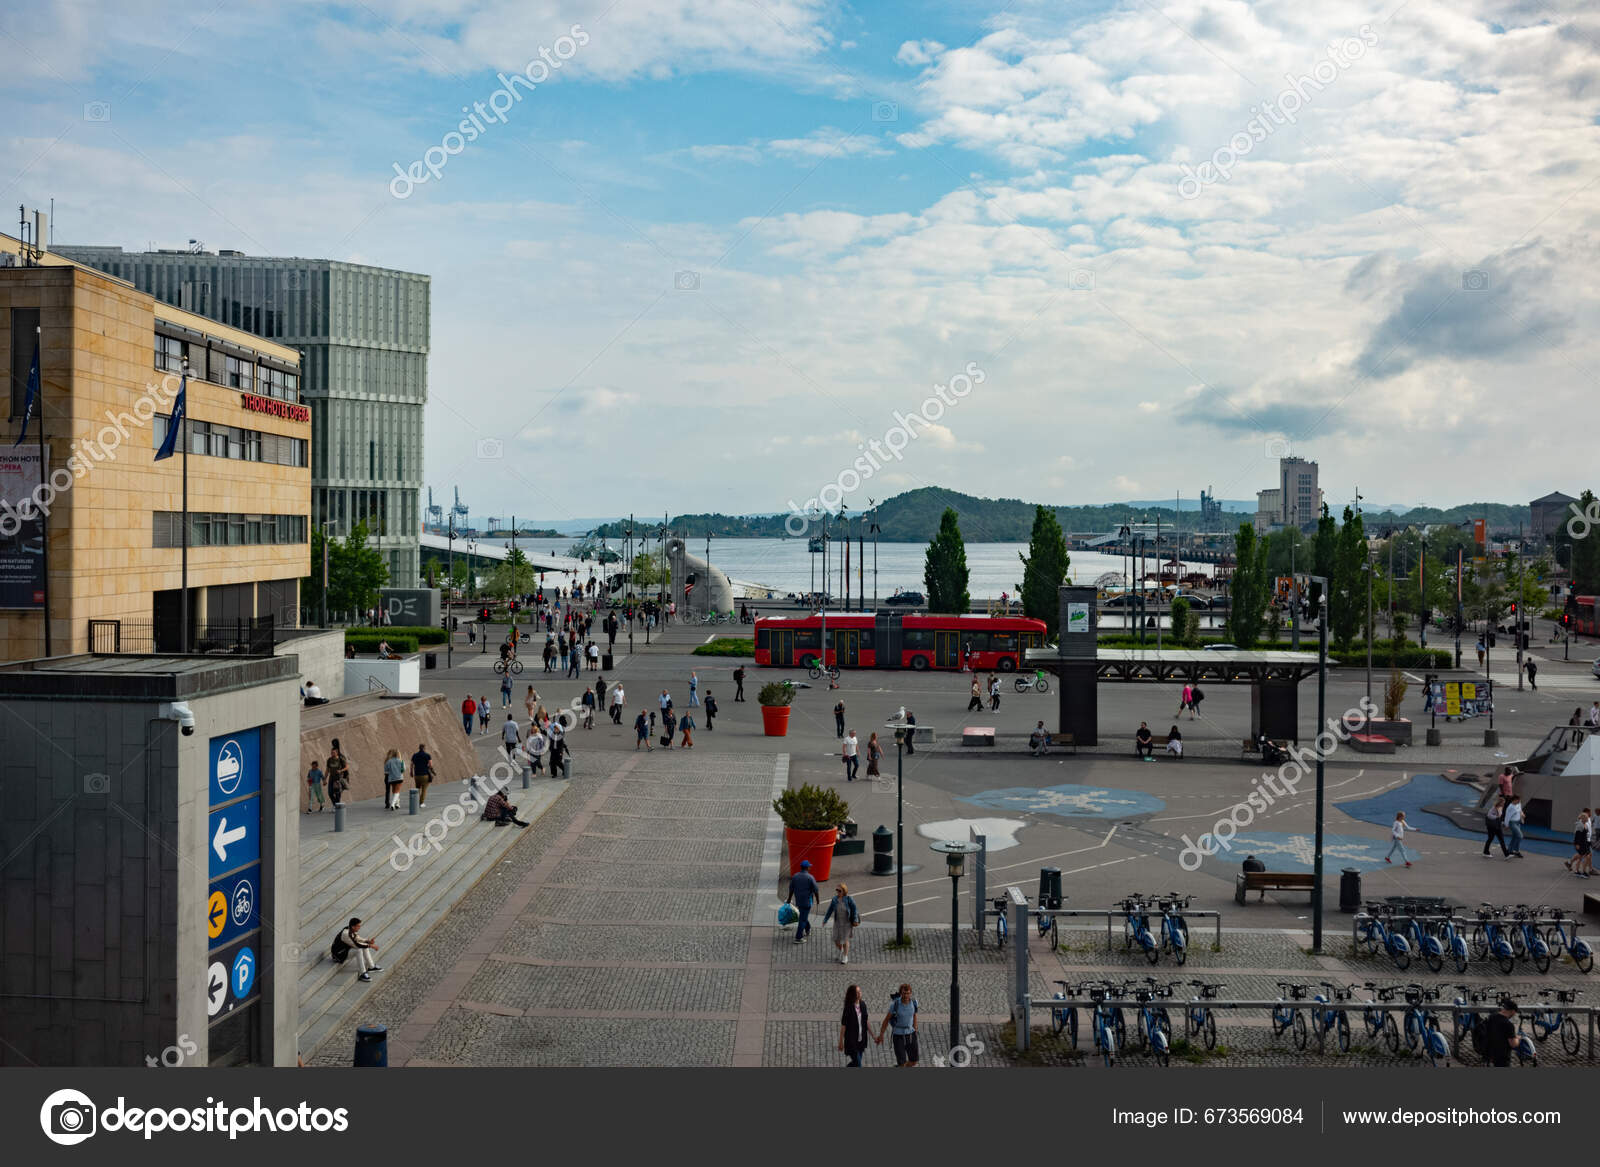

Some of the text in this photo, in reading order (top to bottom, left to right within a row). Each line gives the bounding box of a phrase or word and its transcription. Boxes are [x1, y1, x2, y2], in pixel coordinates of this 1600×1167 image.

[244, 393, 309, 422] THON HOTEL OPERA
[239, 964, 249, 990] P
